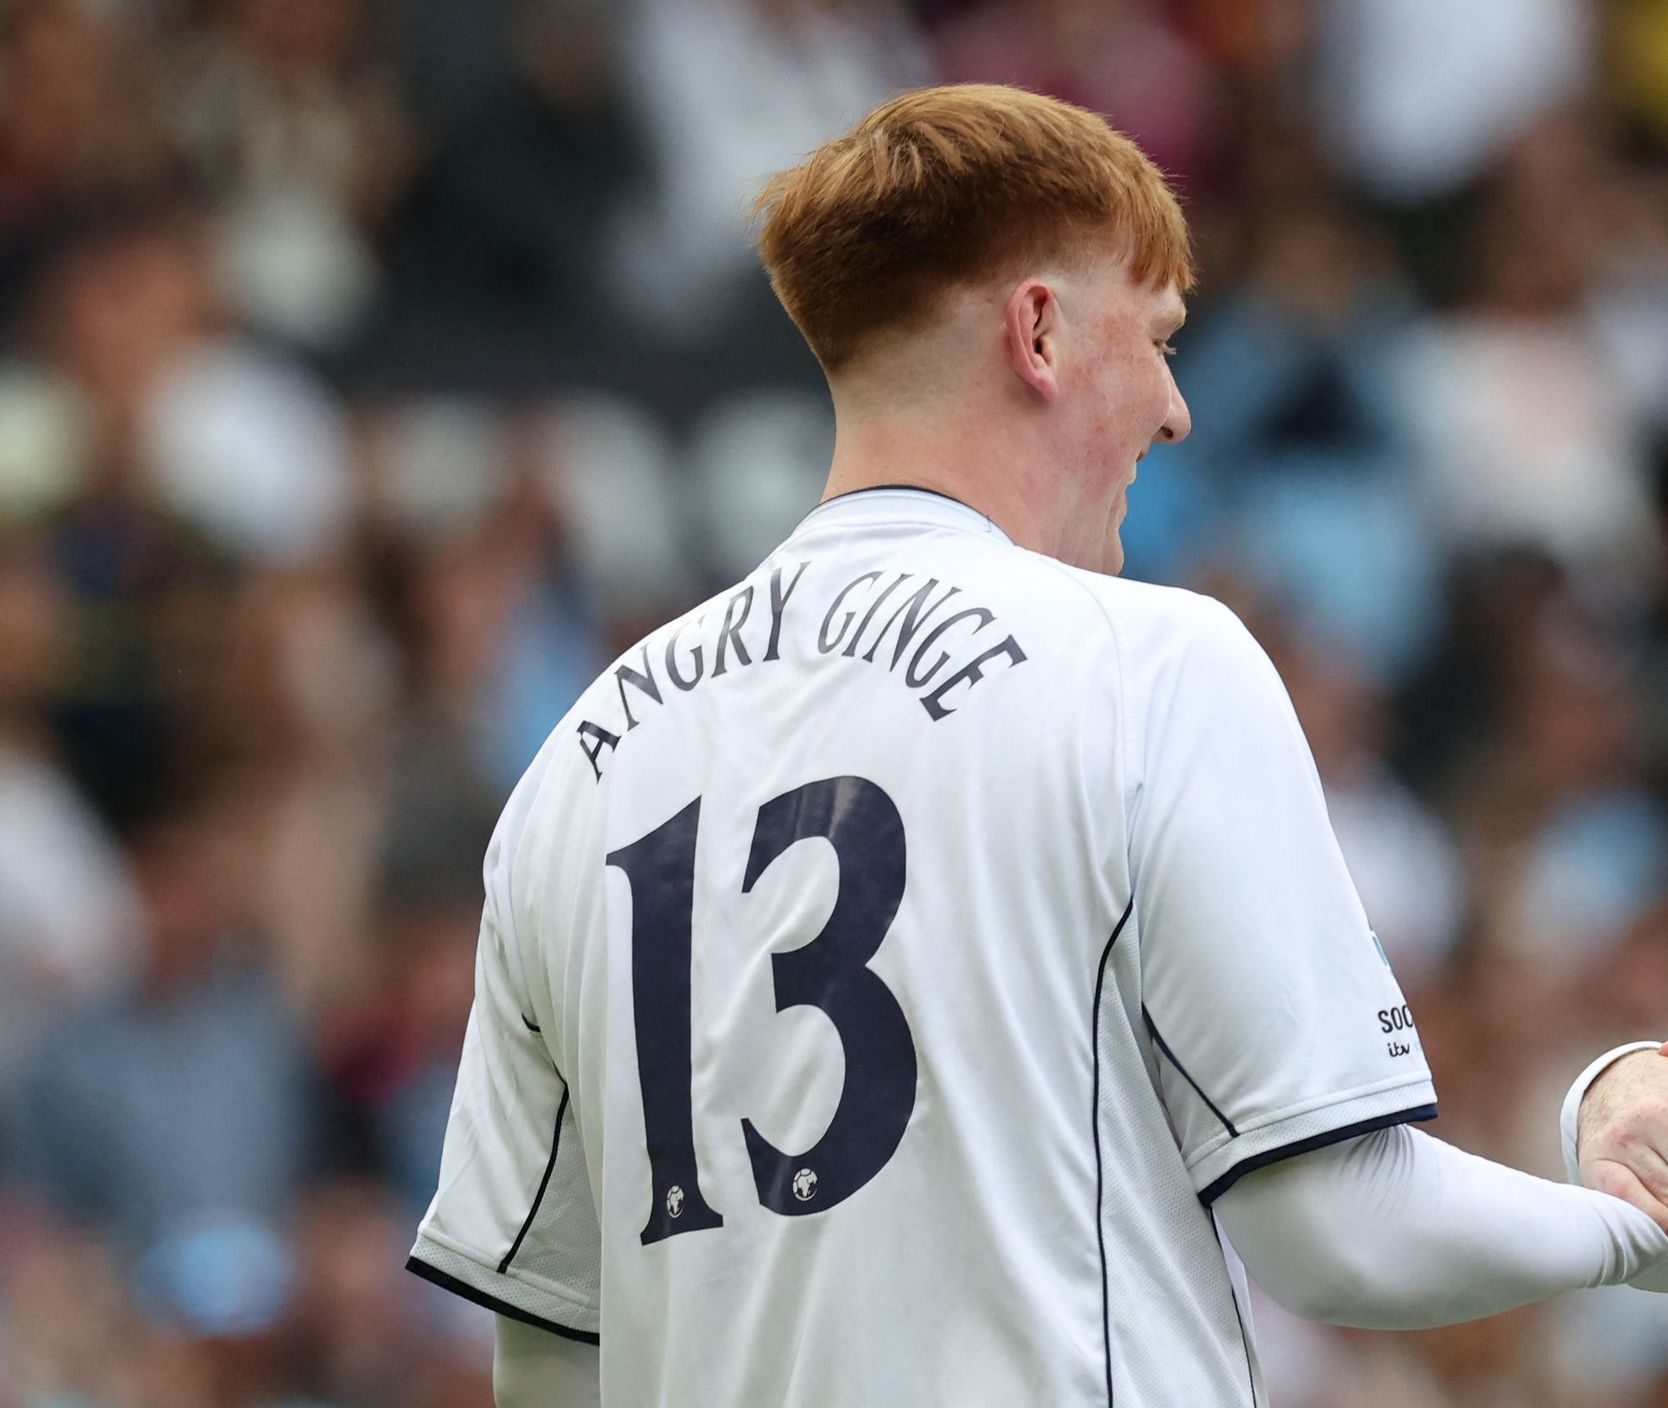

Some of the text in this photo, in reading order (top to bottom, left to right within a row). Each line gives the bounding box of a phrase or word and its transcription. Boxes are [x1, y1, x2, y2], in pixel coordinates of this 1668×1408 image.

[576, 562, 1028, 784] ANGRY GINGE
[605, 775, 917, 1247] 13
[1377, 1004, 1414, 1034] SOC
